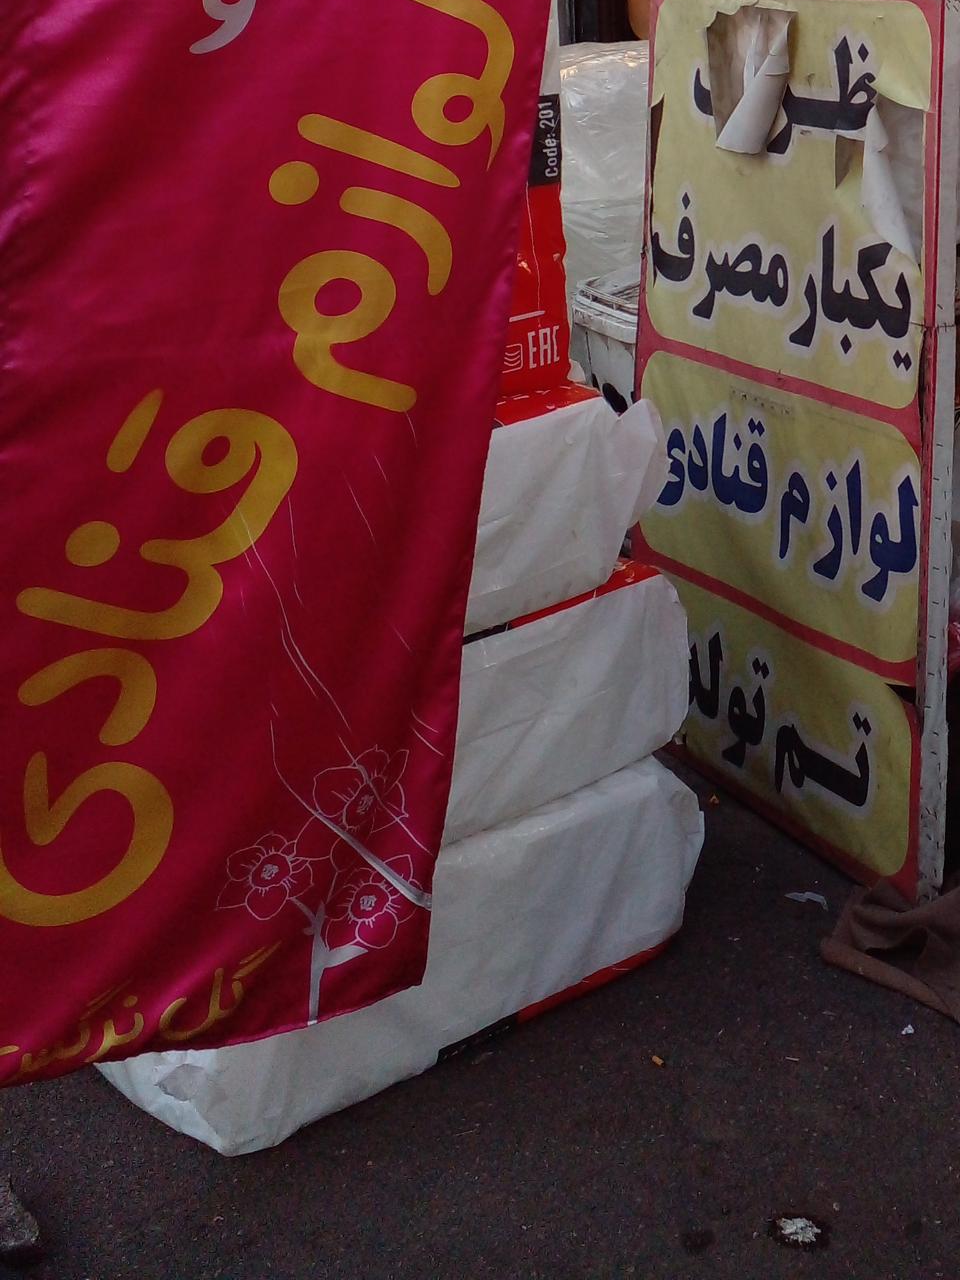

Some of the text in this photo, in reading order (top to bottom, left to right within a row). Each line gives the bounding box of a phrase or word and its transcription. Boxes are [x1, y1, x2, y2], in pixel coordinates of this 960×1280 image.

[538, 100, 560, 179] Code: 201
[651, 191, 914, 373] یکبار مصرف
[656, 411, 920, 603] لوازم قنادی
[0, 388, 299, 927] قنادی
[157, 941, 283, 1042] گل
